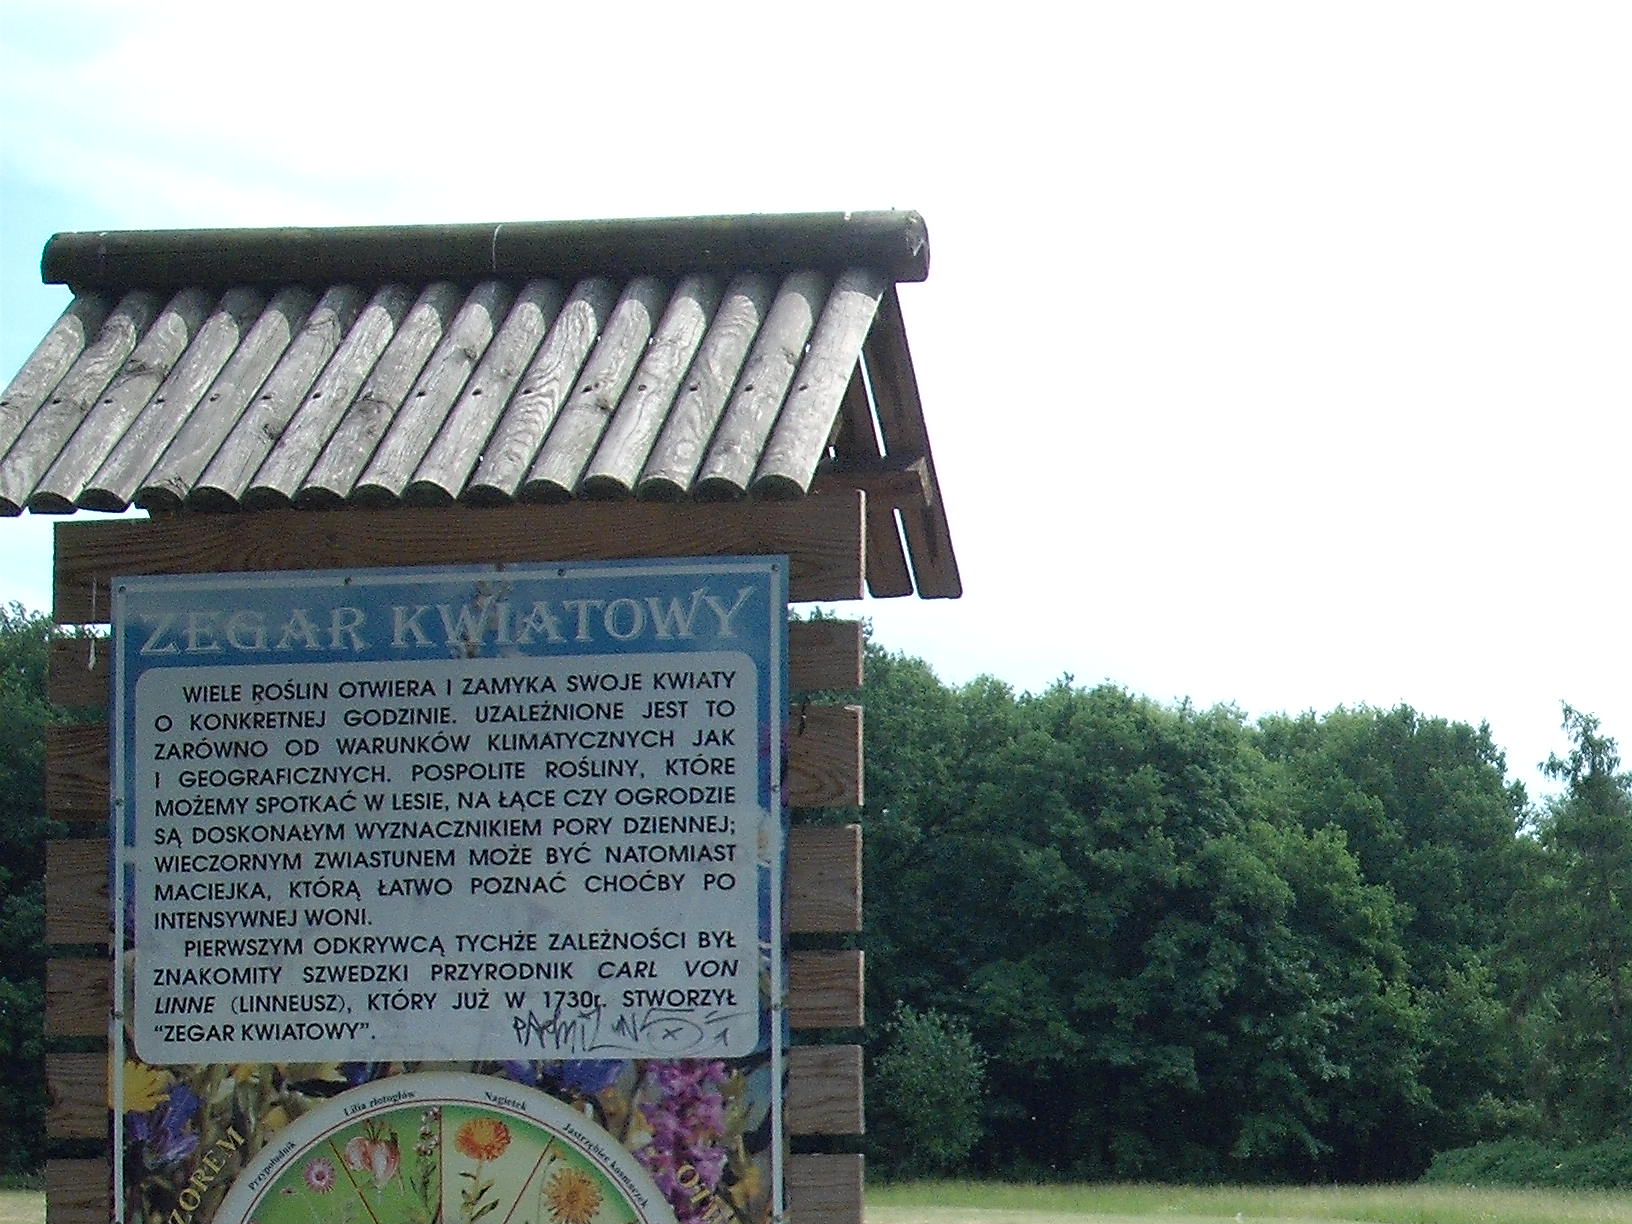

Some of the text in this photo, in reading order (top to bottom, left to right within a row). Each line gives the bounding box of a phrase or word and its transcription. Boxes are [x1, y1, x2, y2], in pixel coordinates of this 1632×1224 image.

[141, 586, 752, 656] ZEGAR KWIATOWY
[183, 671, 736, 705] WIELE ROŚLIN OTWIERA I ZAMYKA SWOJE KWIATY
[155, 700, 735, 732] O KONKRETNEJ GODZINIE. UZALEŹNIONE JEST TO
[155, 729, 735, 760] ZARÓWNO OD WARUNKÓW KLIMATYCZNYCH JAK
[155, 754, 735, 788] I GEOGRAFICZNYCH. POSPOLITE ROŚLINY, KTÓRE
[156, 787, 735, 816] MOŻEMY SPOTKAĆ W LESIE, NA ŁĄCE CZY OGRODZIE
[154, 816, 735, 848] SĄ DOSKONAŁYM WYZNACZNIKIEM PORY DZIENNEJ;
[154, 842, 736, 873] WIECZORNYM ZWIASTUNEM MOŻE BYĆ NATOMIAST
[155, 870, 735, 901] MACIEJKA, KTÓRĄ ŁATWO POZNAĆ CHOĆBY PO
[155, 909, 372, 930] INTENSYWNEJ WONI.
[185, 927, 736, 957] PIERWSZYM ODKRYWCĄ TYCHŻE ZALEŻNOŚCI BYŁ
[154, 960, 738, 986] ZNAKOMITY SZWEDZKI PRZYRODNIK CARL VON
[155, 988, 738, 1014] LINNE (LINNEUSZ), KTÓRY JUŻ W 1730r. STWORZYŁ
